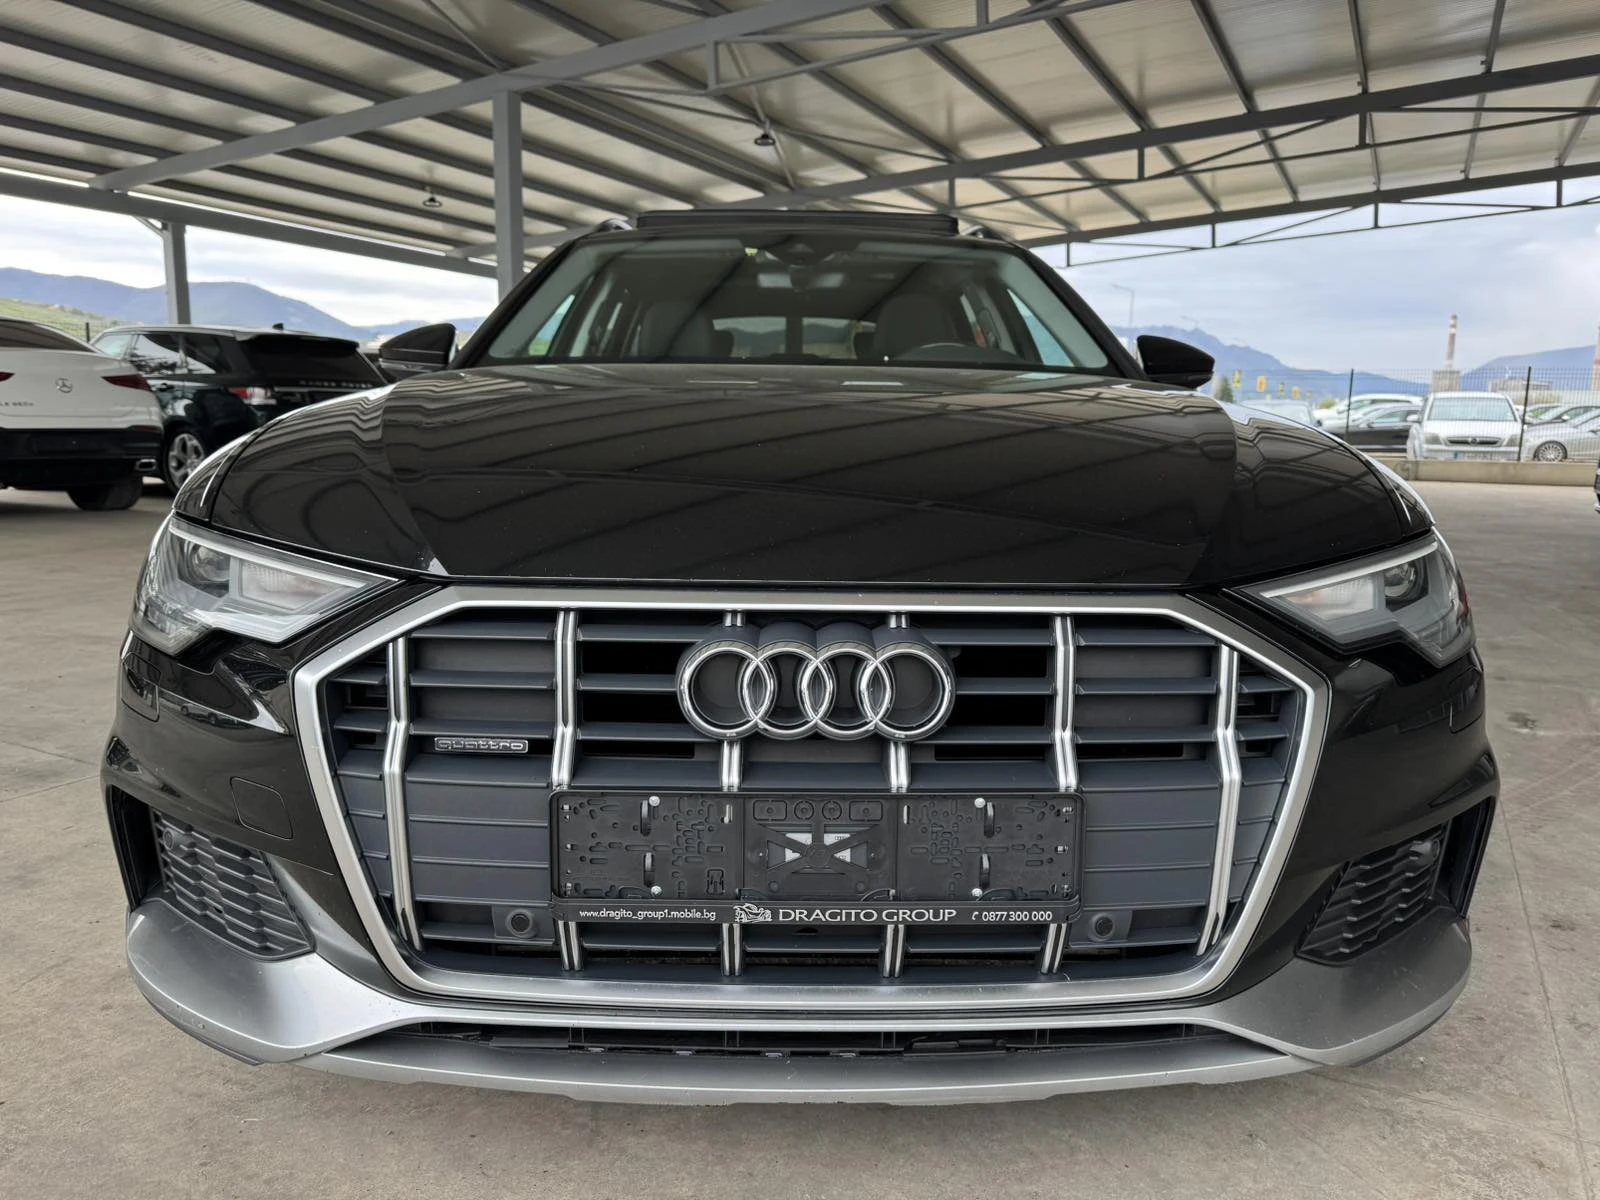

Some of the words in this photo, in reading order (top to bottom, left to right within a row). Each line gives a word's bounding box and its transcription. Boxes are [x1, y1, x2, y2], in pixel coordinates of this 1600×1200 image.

[438, 740, 524, 750] quattro
[579, 908, 716, 921] www.dragito_group1.mobile.bg
[779, 909, 878, 922] DRAGITO
[882, 909, 957, 922] GROUP
[982, 911, 1007, 921] 0877
[1009, 911, 1030, 921] 300
[1031, 911, 1053, 921] 000
